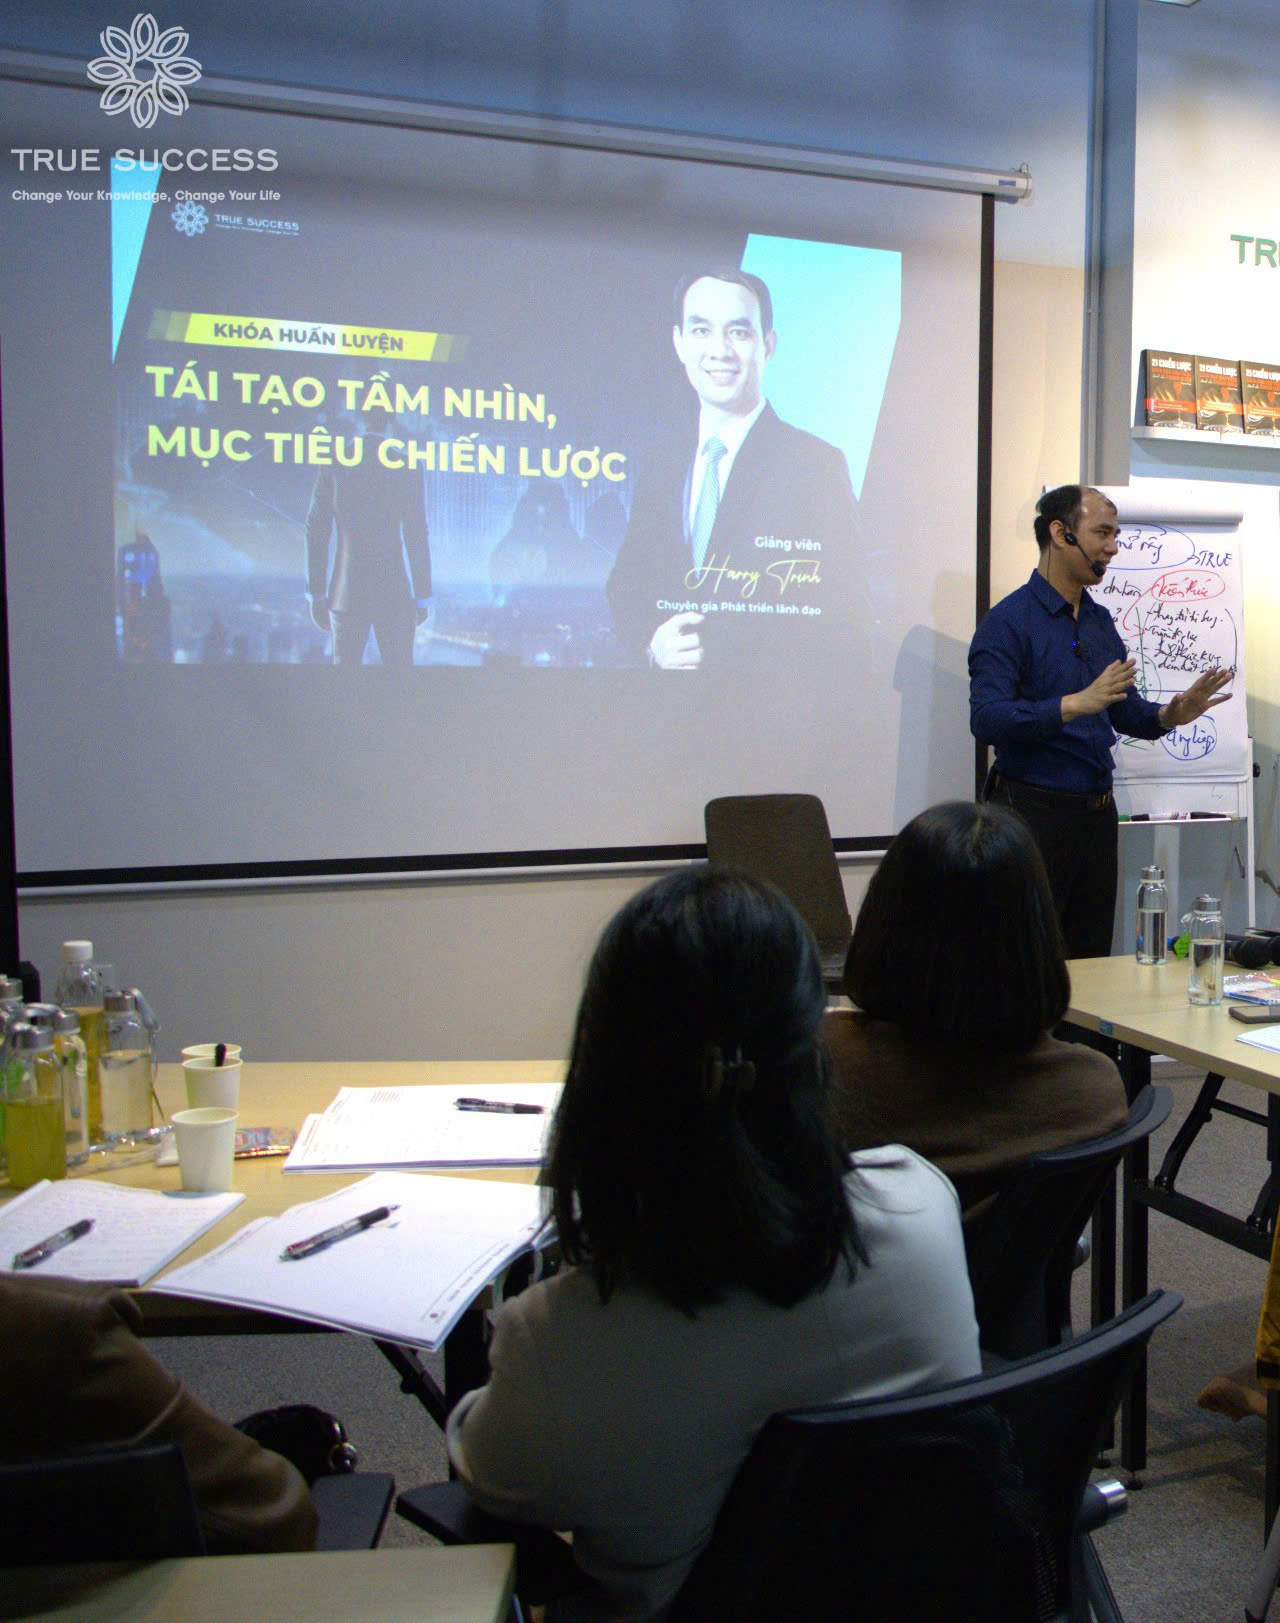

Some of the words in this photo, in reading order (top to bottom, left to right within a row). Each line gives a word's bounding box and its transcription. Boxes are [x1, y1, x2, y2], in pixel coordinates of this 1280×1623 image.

[215, 214, 243, 224] TRUE
[247, 217, 299, 231] SUCCESS
[213, 320, 273, 341] KHÓA
[279, 325, 336, 346] HUẤN
[341, 332, 404, 354] LUYỆN
[145, 360, 218, 401] TÁI
[233, 372, 326, 414] TẠO
[337, 370, 430, 415] TẦM
[444, 383, 558, 430] NHÌN,
[148, 424, 252, 468] MỤC
[264, 425, 364, 467] TIÊU
[377, 432, 505, 475] CHIẾN
[519, 444, 627, 488] LƯỢC
[754, 535, 792, 552] Giảng
[794, 538, 822, 551] viên
[1199, 549, 1233, 568] TRUE
[684, 553, 760, 599] Harry
[656, 599, 698, 613] Chuyên
[701, 602, 719, 613] gia
[720, 601, 746, 612] Phát
[748, 601, 774, 613] triển
[775, 602, 799, 614] lãnh
[801, 604, 822, 616] đạo
